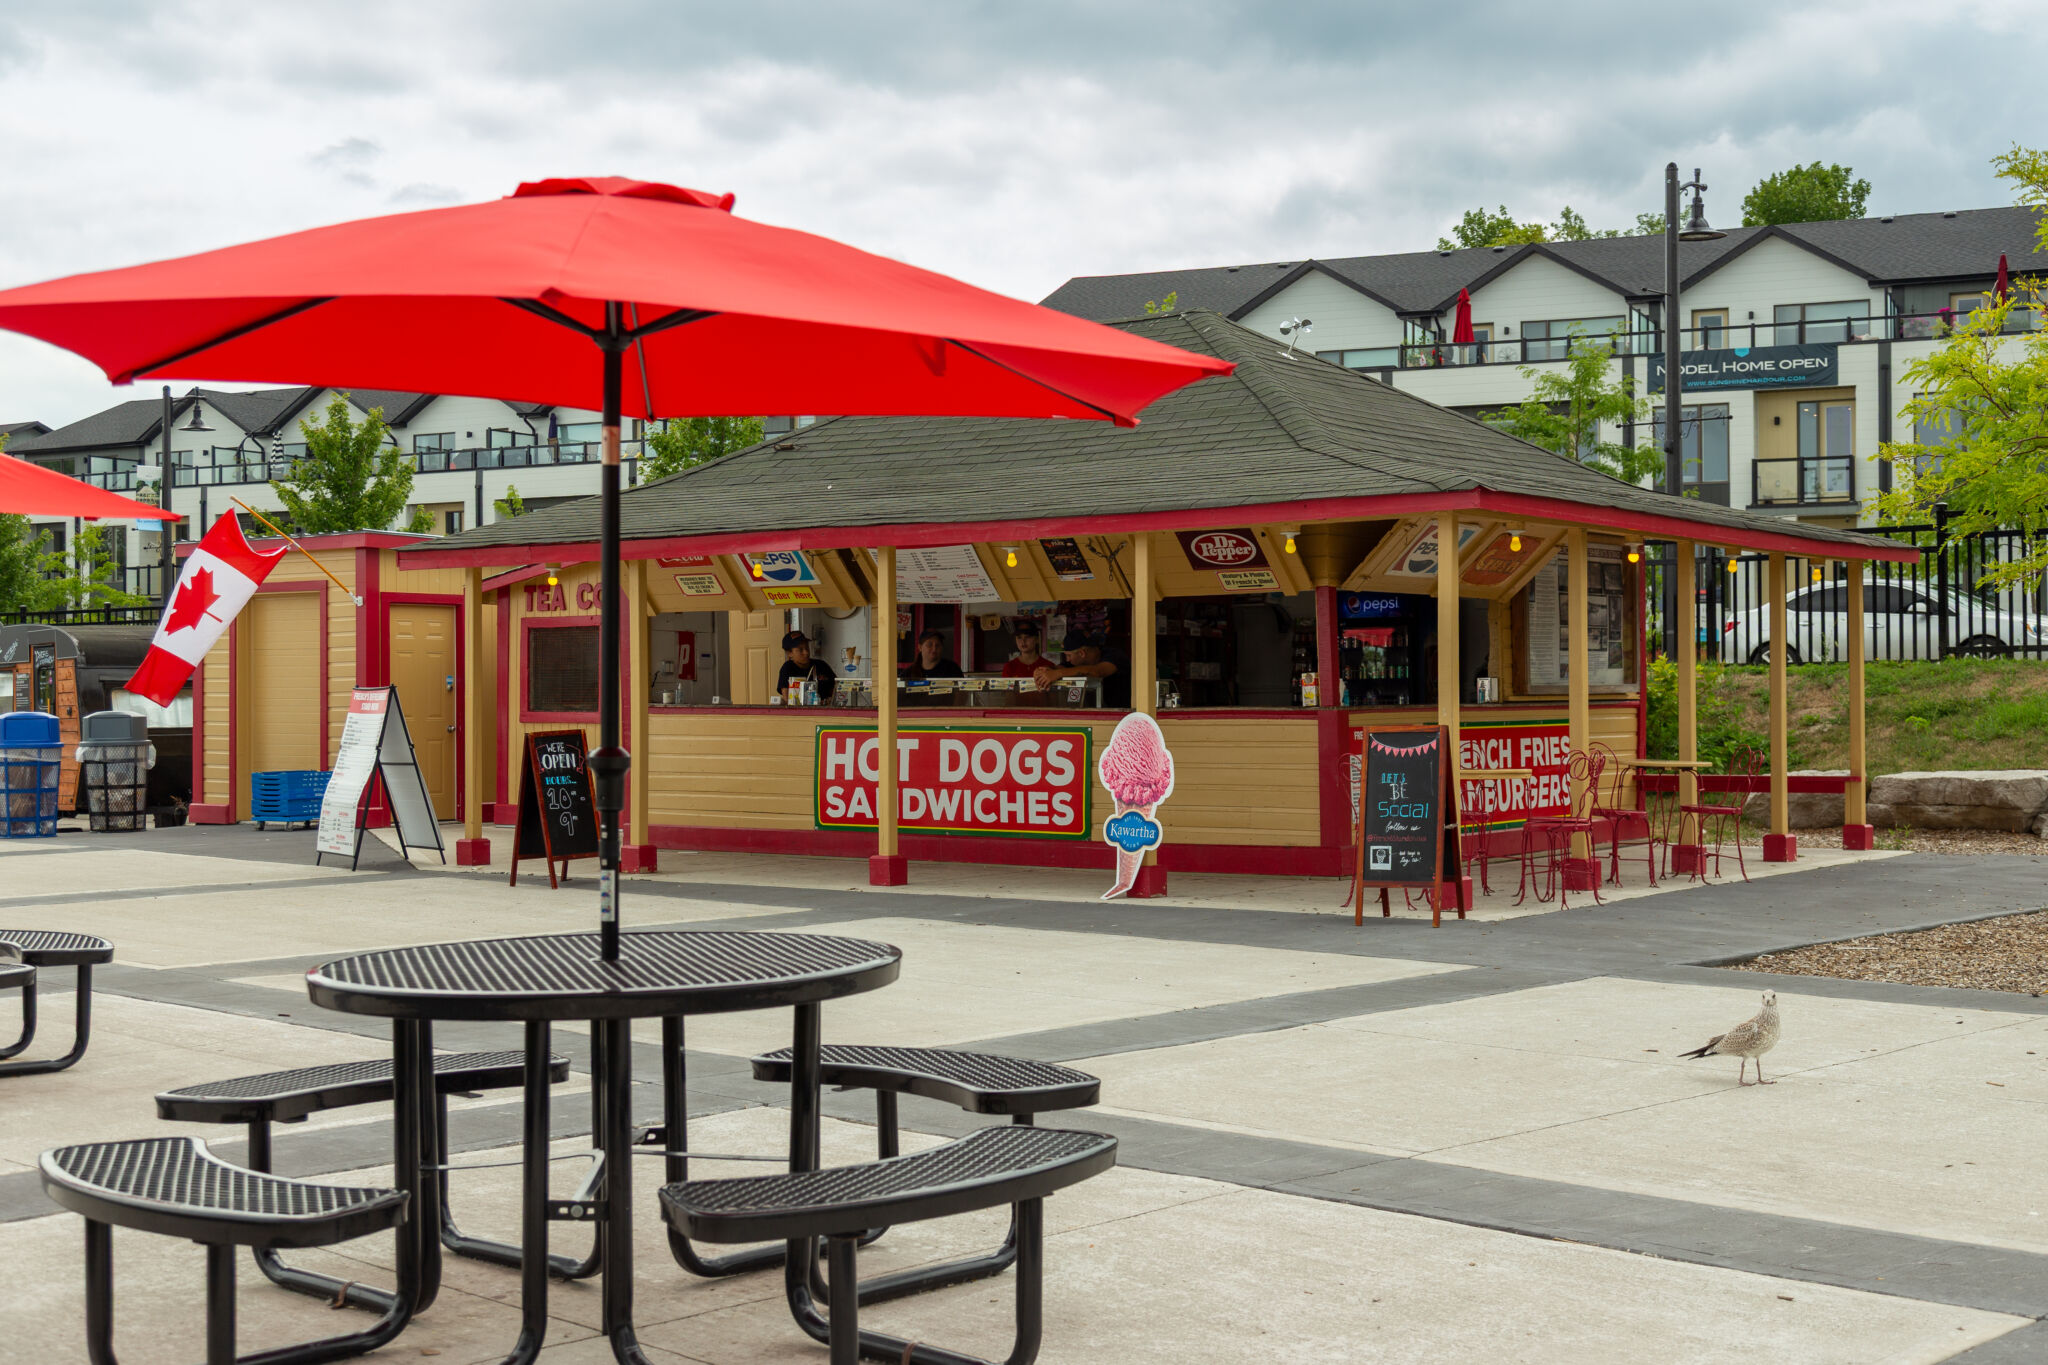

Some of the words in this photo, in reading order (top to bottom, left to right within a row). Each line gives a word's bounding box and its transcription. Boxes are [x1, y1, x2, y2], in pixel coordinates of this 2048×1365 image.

[1722, 360, 1776, 373] HOME
[1779, 358, 1828, 370] OPEN
[1212, 535, 1236, 548] Dr
[1413, 541, 1438, 555] PEP
[1199, 542, 1252, 560] Pepper
[524, 583, 567, 612] TEA
[767, 592, 791, 601] Order
[793, 591, 813, 600] Here
[1363, 596, 1399, 611] pepsi
[541, 753, 576, 769] OPEN
[1459, 738, 1512, 770] ENCH
[1520, 736, 1570, 767] FRIES
[939, 738, 1075, 787] DOGS
[1389, 783, 1409, 800] BE
[825, 786, 1075, 826] SADWICHES
[1378, 801, 1429, 819] Social
[1110, 823, 1155, 839] Kawartha
